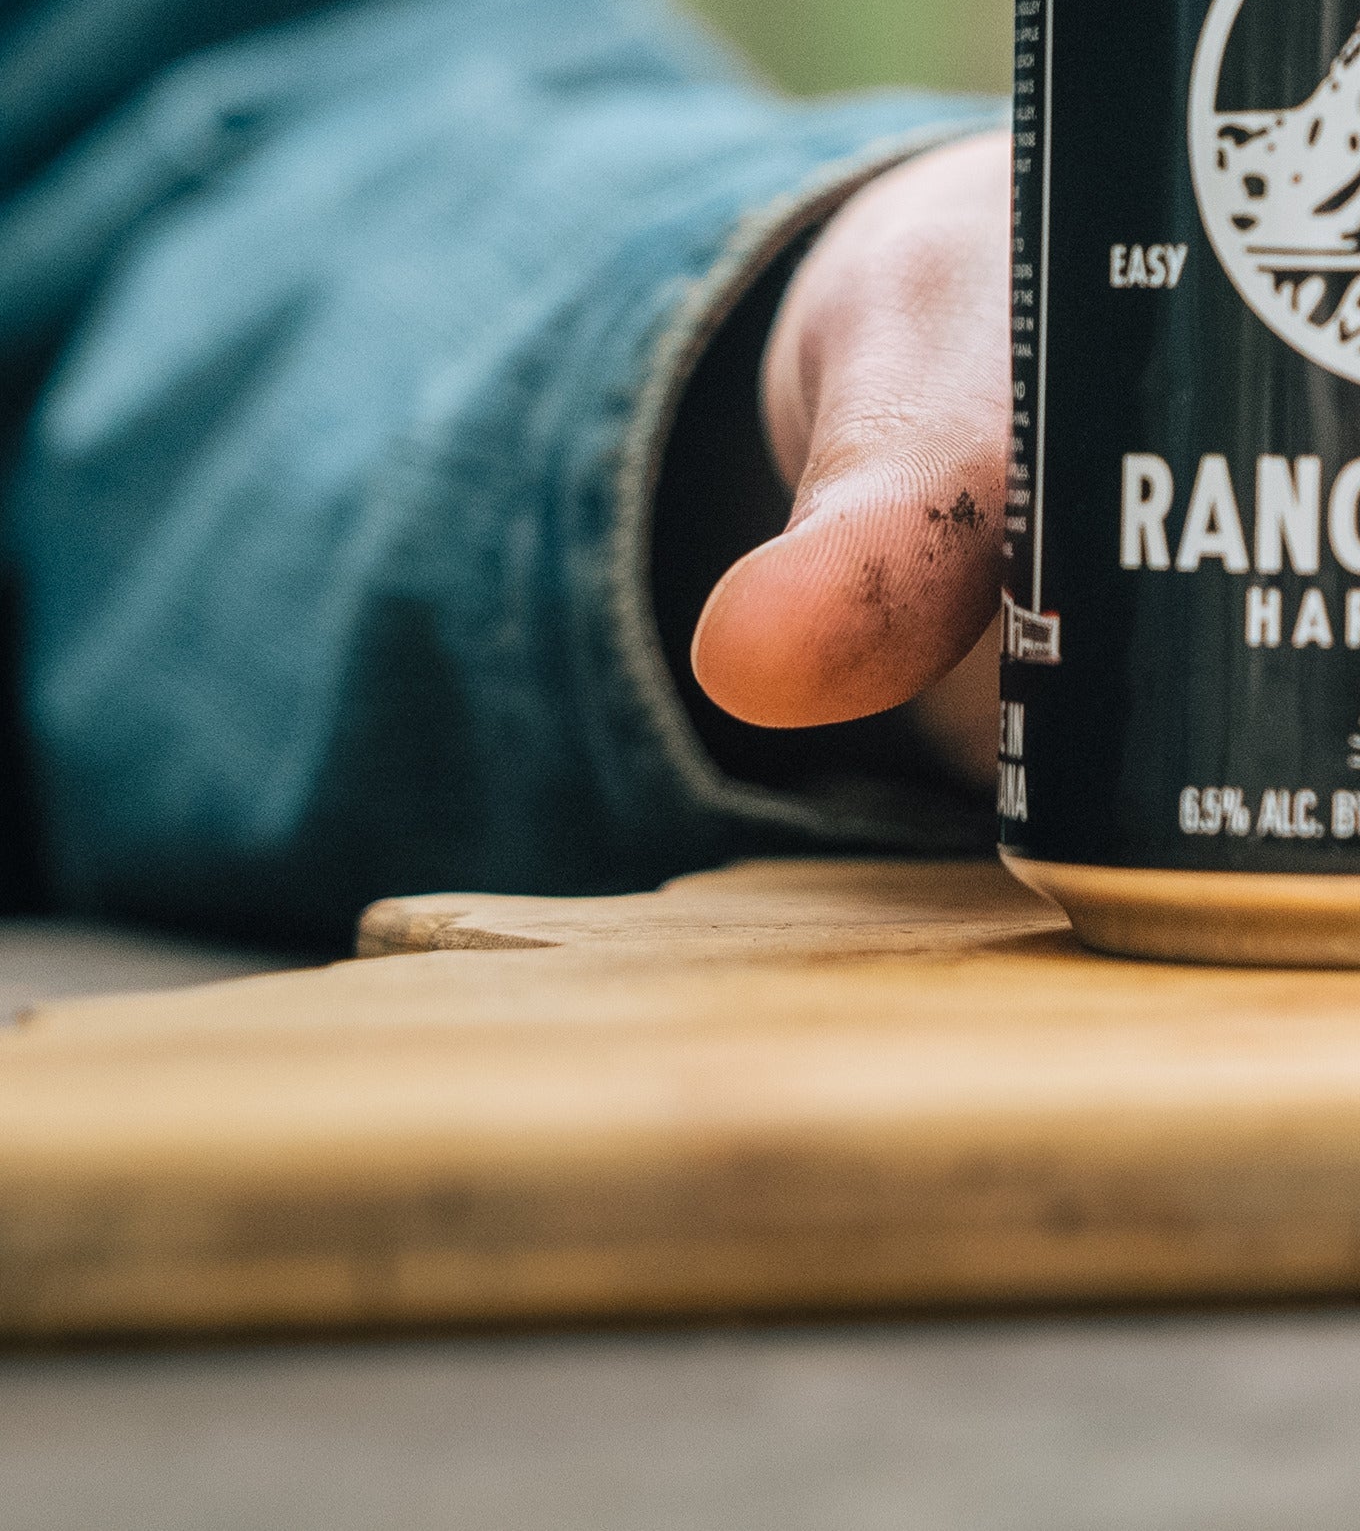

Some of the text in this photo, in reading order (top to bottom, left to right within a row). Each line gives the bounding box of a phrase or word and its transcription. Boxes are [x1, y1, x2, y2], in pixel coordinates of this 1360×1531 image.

[1109, 243, 1188, 290] EASY
[1179, 786, 1250, 836] 6.5%
[1257, 787, 1325, 839] ALC.
